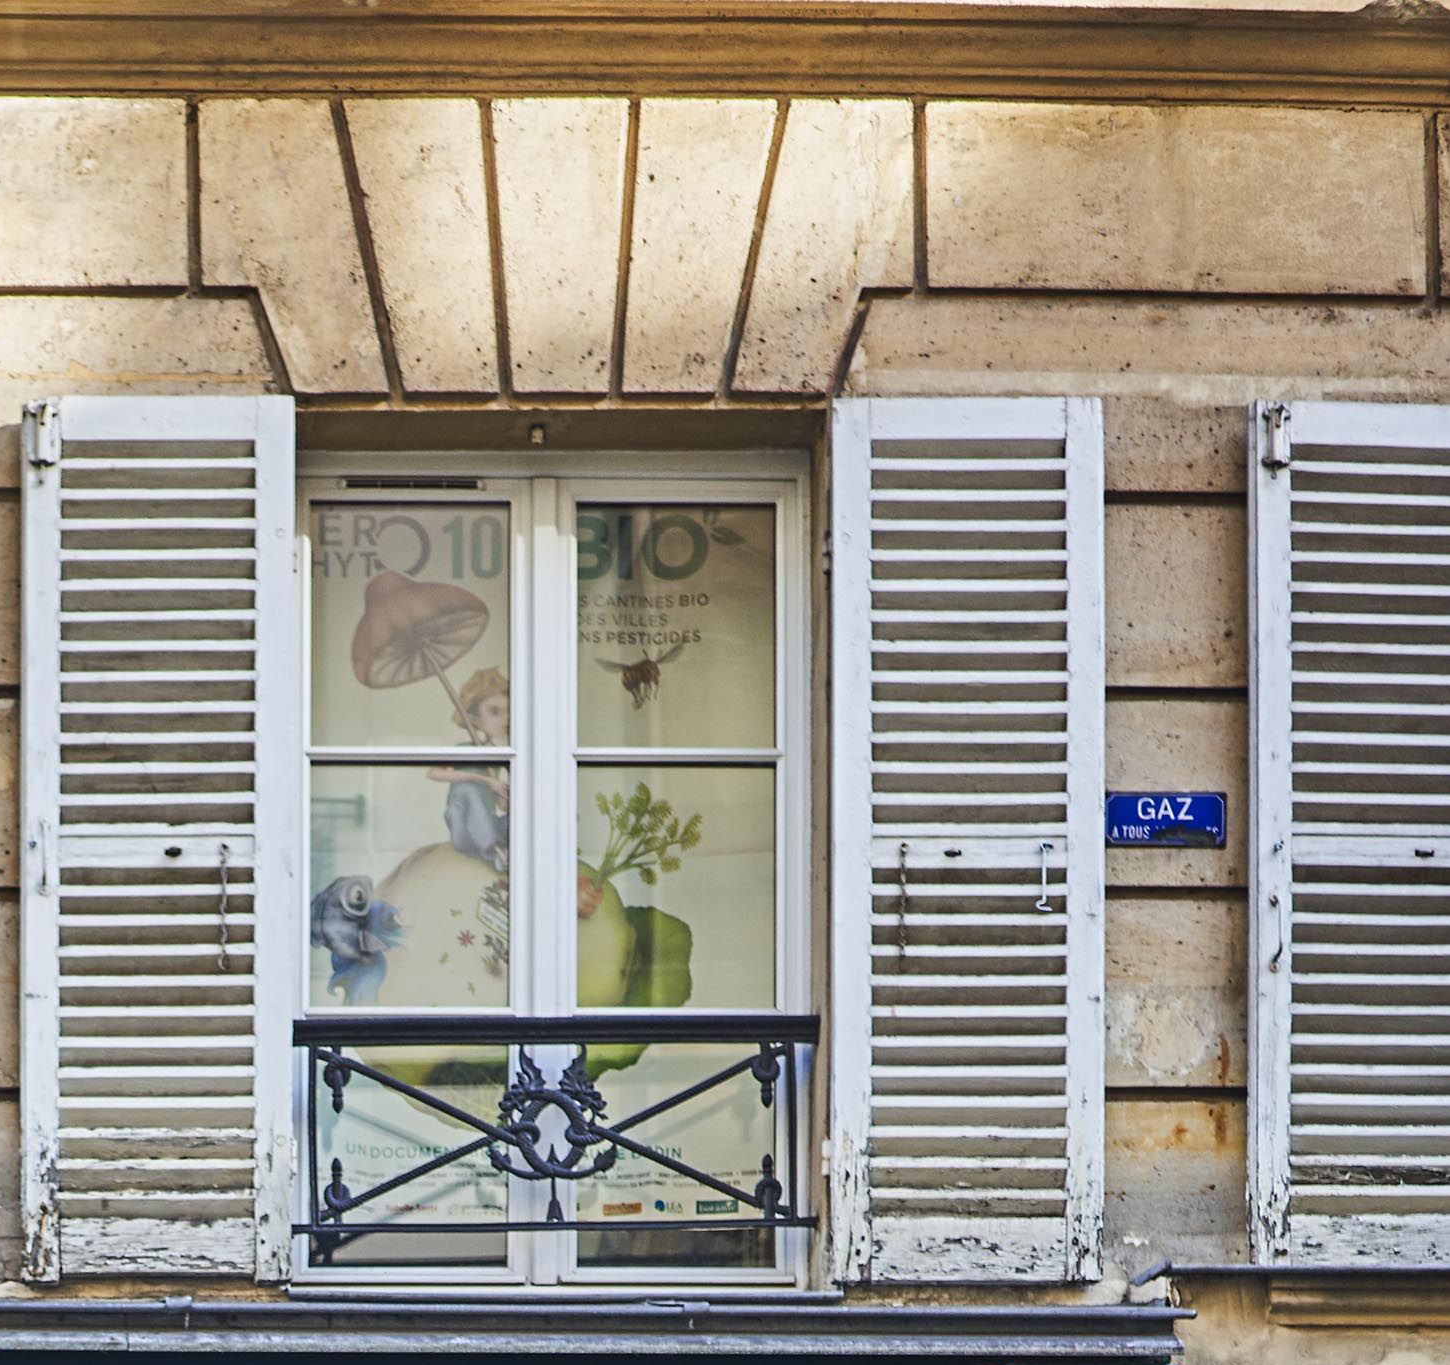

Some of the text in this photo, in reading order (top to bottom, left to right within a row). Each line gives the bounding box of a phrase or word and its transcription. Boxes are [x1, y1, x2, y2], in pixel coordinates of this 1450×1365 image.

[594, 594, 675, 609] CANTINES
[678, 593, 710, 608] BIO
[612, 613, 668, 628] VILLES
[606, 630, 702, 645] PESTICIDES
[1137, 797, 1194, 820] GAZ
[1122, 825, 1150, 839] TOUS
[345, 1142, 367, 1155] UN
